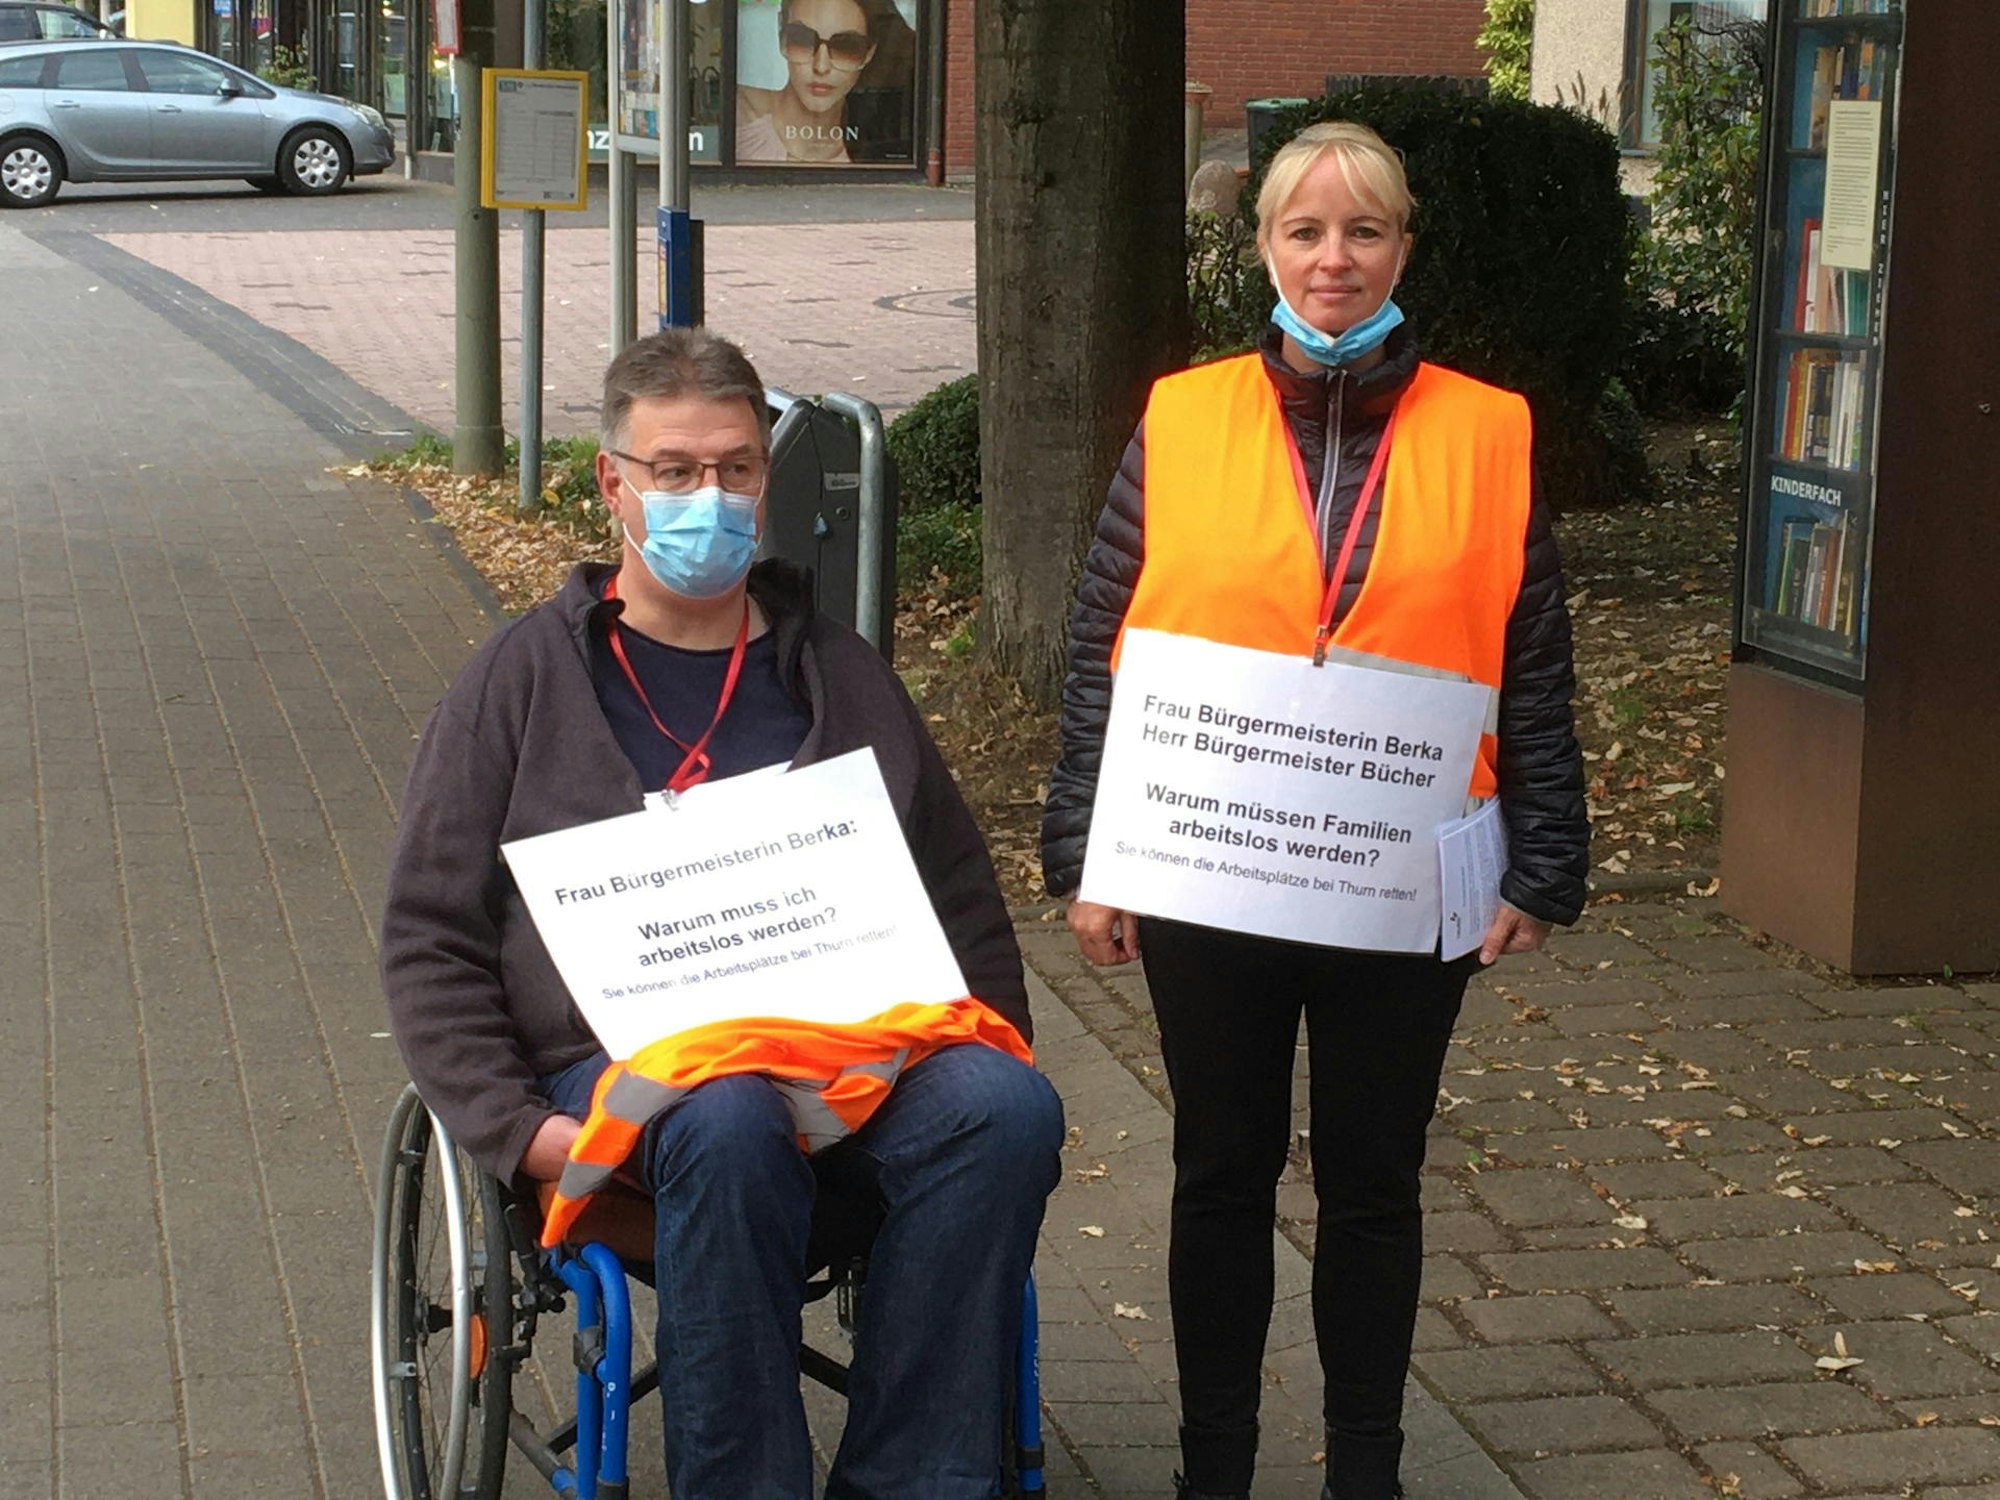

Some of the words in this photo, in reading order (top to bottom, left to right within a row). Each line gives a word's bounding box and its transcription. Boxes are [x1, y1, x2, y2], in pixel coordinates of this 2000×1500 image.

[785, 125, 860, 141] BOLON
[1771, 475, 1842, 507] KINDERFACH
[1142, 722, 1189, 748] Herr
[1194, 732, 1355, 776] Bürgermeister
[1360, 760, 1436, 787] Bücher
[1144, 694, 1191, 720] Frau
[1197, 704, 1378, 752] Bürgermeisterin
[1384, 735, 1443, 761] Berka
[1146, 782, 1220, 814] Warum
[1226, 800, 1315, 830] müssen
[1323, 813, 1412, 843] Familien
[1168, 818, 1279, 852] arbeitslos
[1286, 840, 1380, 868] werden?
[554, 883, 606, 906] Frau
[609, 841, 783, 894] Bürgermeisterin
[787, 819, 858, 850] Berka:
[1115, 841, 1138, 857] Sie
[1140, 849, 1190, 867] können
[1193, 857, 1215, 871] die
[1216, 861, 1310, 888] Arbeitsplätze
[1313, 876, 1334, 892] bei
[1378, 888, 1417, 902] retten!
[637, 912, 717, 941] Warum
[720, 898, 779, 922] muss
[782, 886, 817, 907] ich
[638, 932, 744, 967] arbeitslos
[747, 906, 837, 942] werden?
[602, 987, 625, 1000] Sie
[626, 978, 677, 996] können
[680, 973, 701, 986] die
[703, 952, 789, 981] Arbeitsplätze
[791, 948, 813, 961] bei
